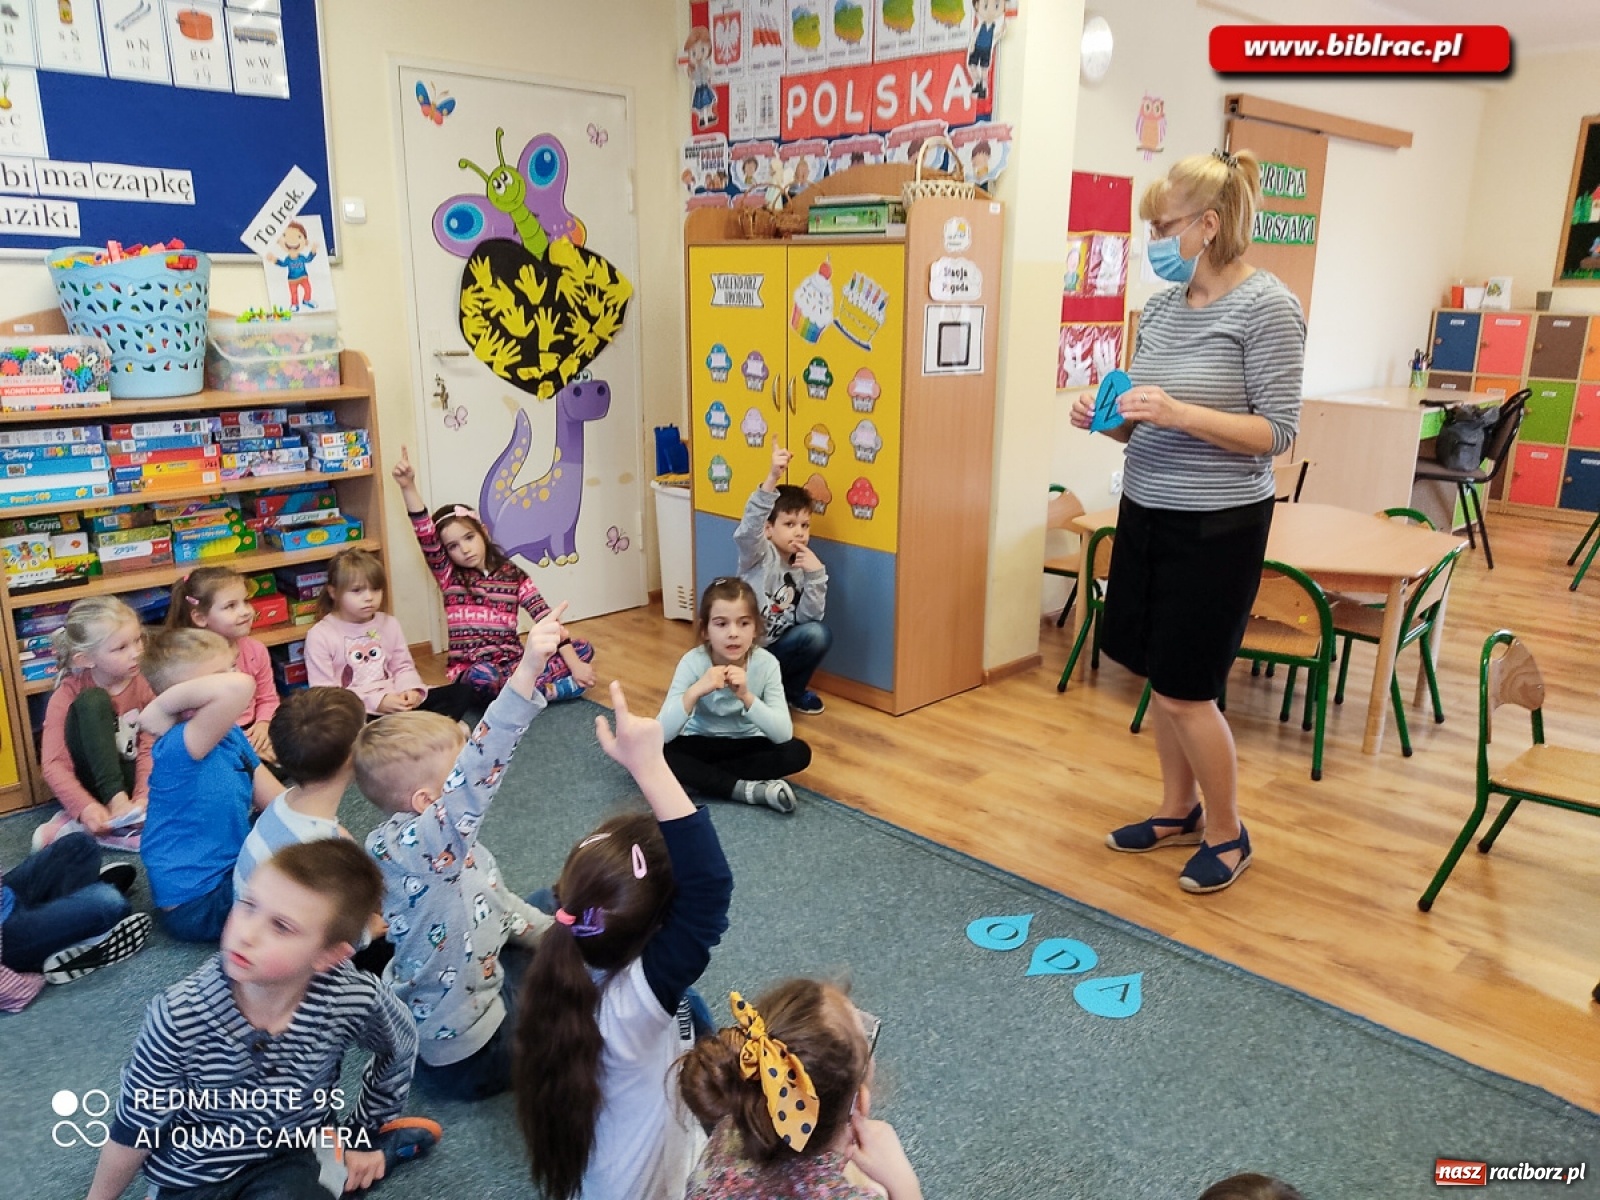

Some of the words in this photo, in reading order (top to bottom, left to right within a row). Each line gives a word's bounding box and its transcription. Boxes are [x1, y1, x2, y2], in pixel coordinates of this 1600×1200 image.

[786, 63, 972, 130] POLSKA
[42, 167, 88, 189] ma
[95, 169, 191, 201] czapkę
[253, 224, 277, 245] To
[271, 189, 305, 225] Irek.
[1043, 949, 1081, 970] D
[1097, 983, 1130, 1004] A
